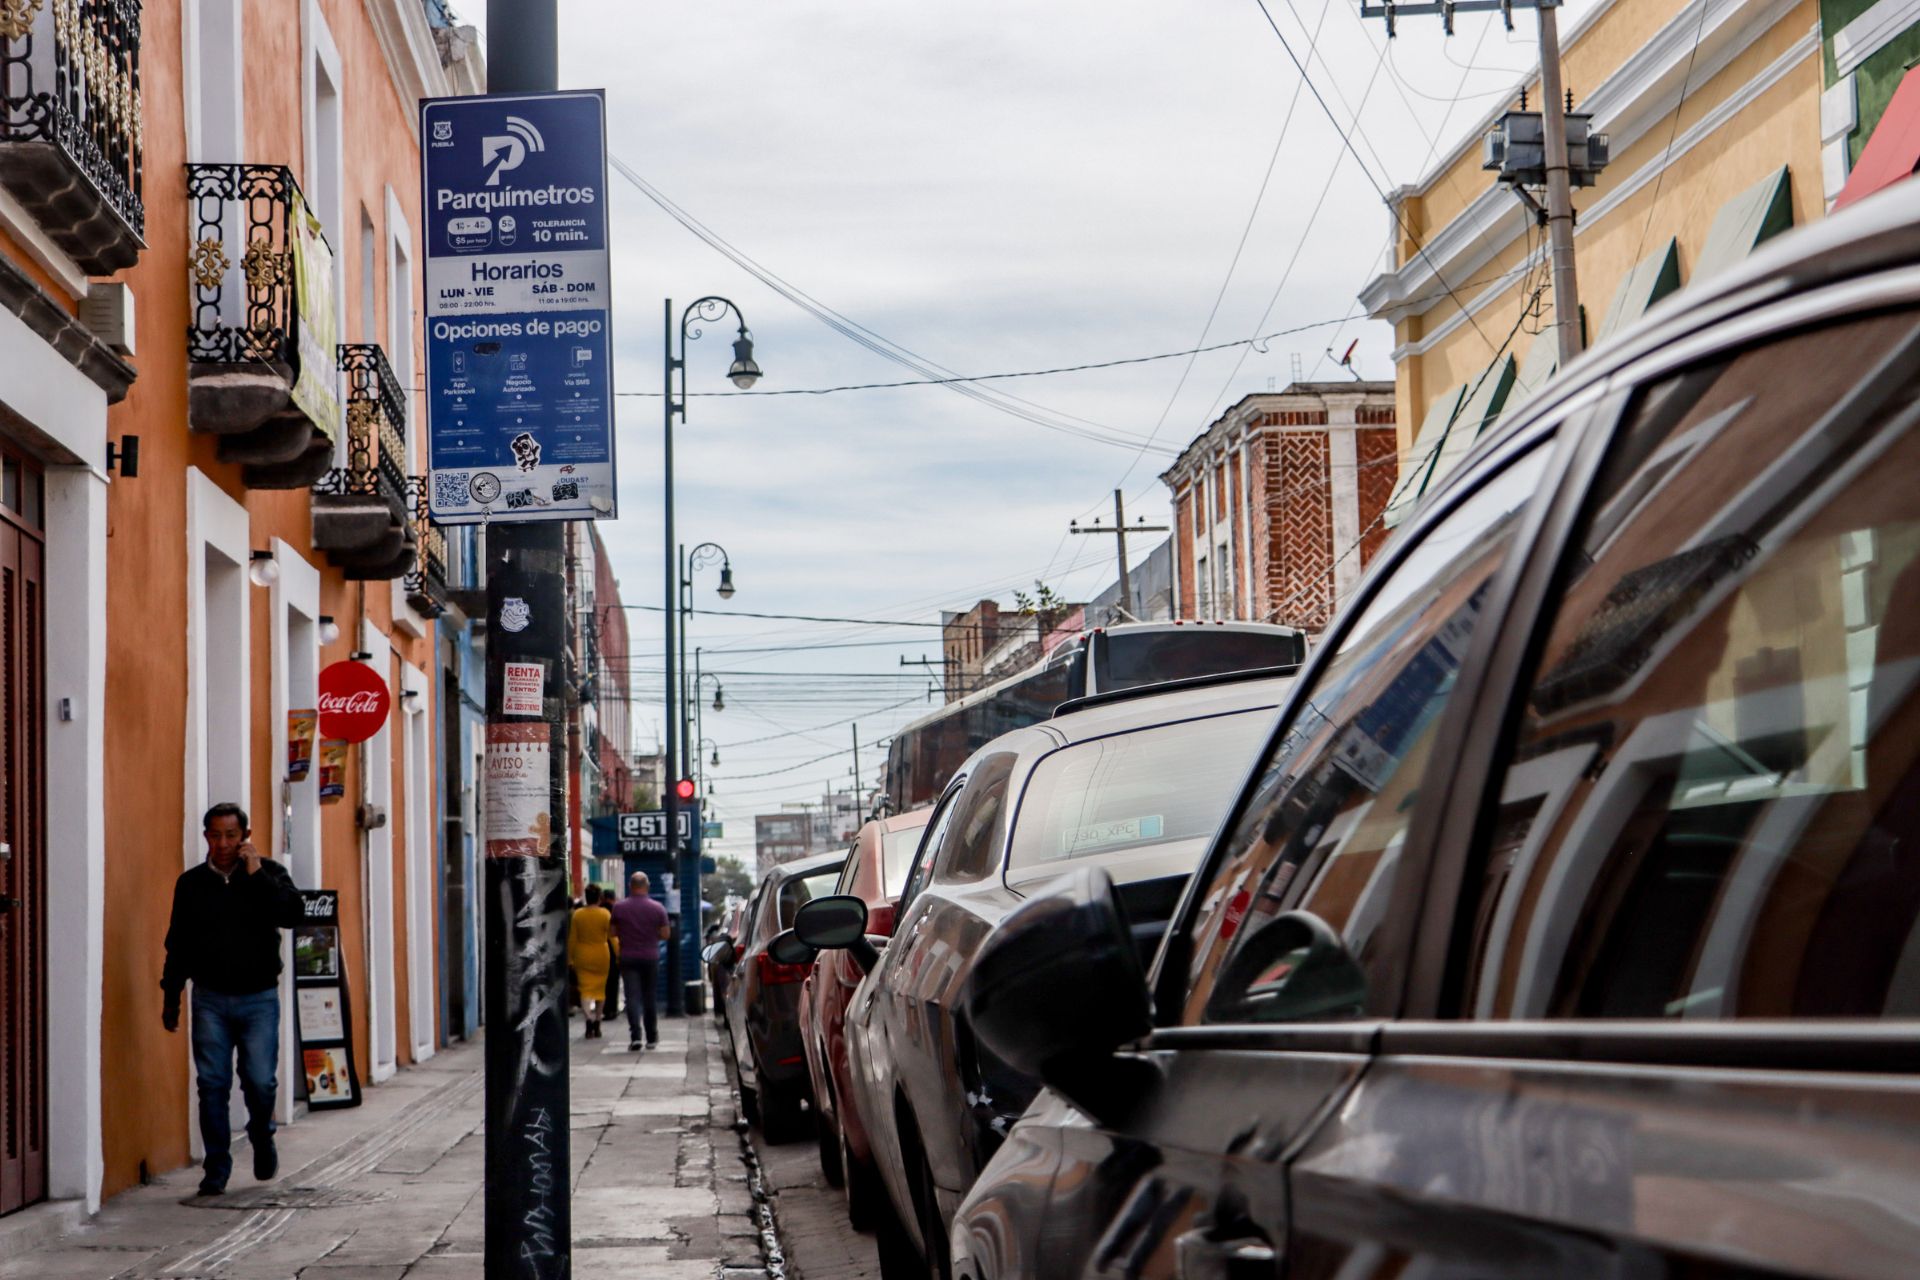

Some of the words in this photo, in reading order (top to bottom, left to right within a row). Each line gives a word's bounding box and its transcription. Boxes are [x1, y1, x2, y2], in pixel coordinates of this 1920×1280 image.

[438, 185, 595, 213] Parquímetros
[532, 219, 586, 228] TOLERANCIA
[533, 229, 551, 242] 10
[555, 228, 589, 242] min.
[471, 260, 564, 282] Horarios
[440, 289, 465, 299] LUN
[475, 286, 494, 297] VIE
[532, 281, 558, 294] SÁB
[567, 282, 596, 293] DOM
[434, 321, 522, 342] Opciones
[526, 319, 550, 335] de
[554, 320, 602, 338] pago
[507, 667, 540, 678] RENTA
[491, 757, 523, 769] AVISO
[623, 840, 636, 851] DE
